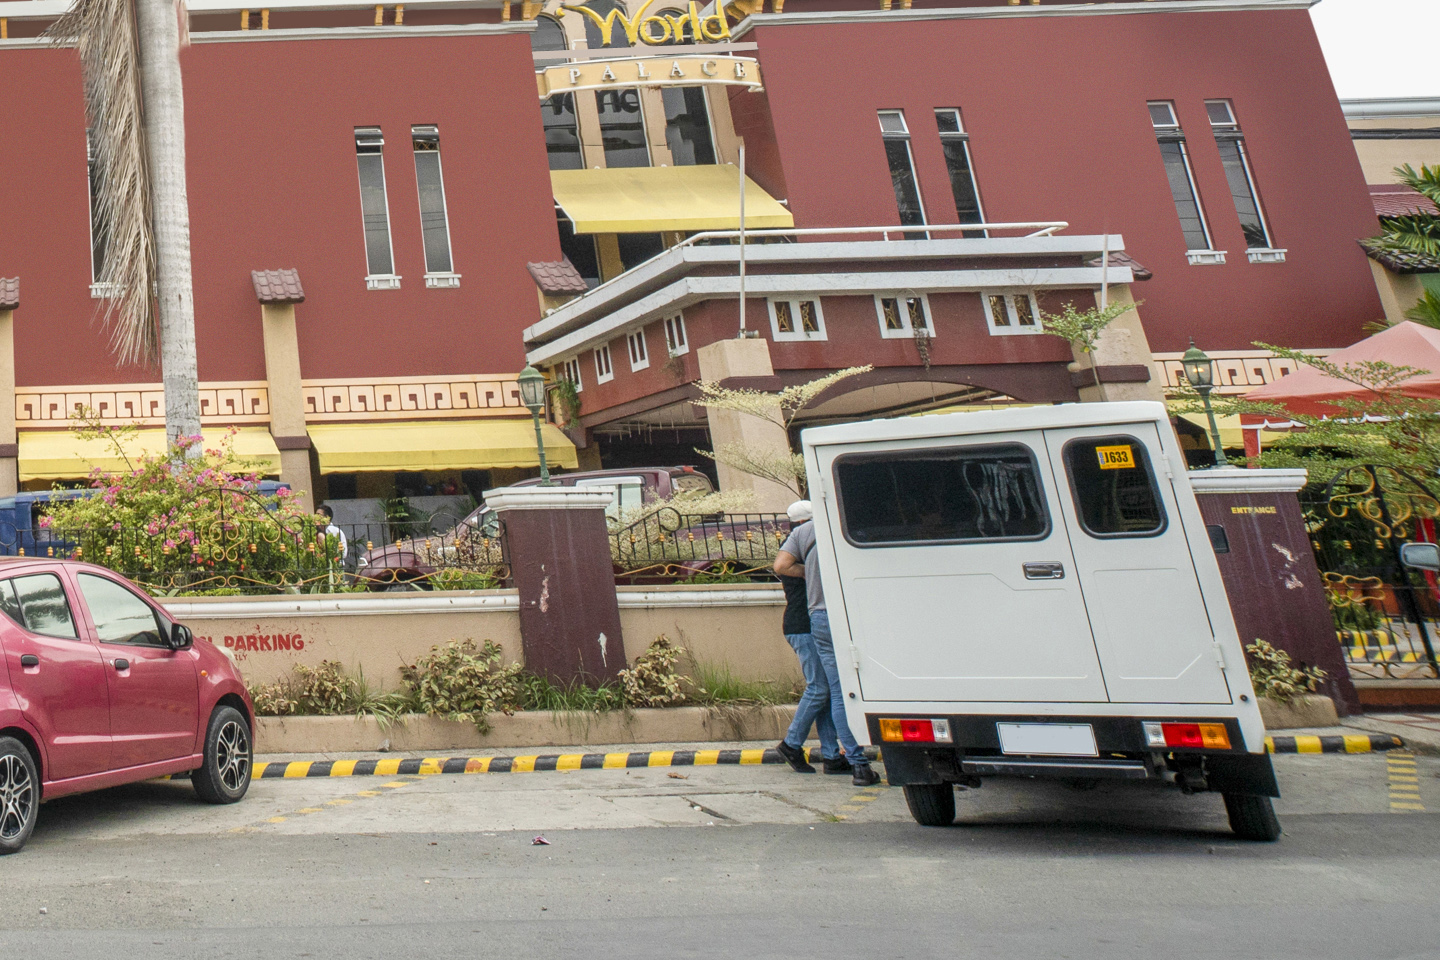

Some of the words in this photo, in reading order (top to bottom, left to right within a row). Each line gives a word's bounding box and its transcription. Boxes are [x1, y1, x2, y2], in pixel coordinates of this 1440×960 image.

[568, 60, 748, 85] PALACE
[1230, 506, 1277, 515] ENTRANCE
[224, 633, 305, 651] PARKING
